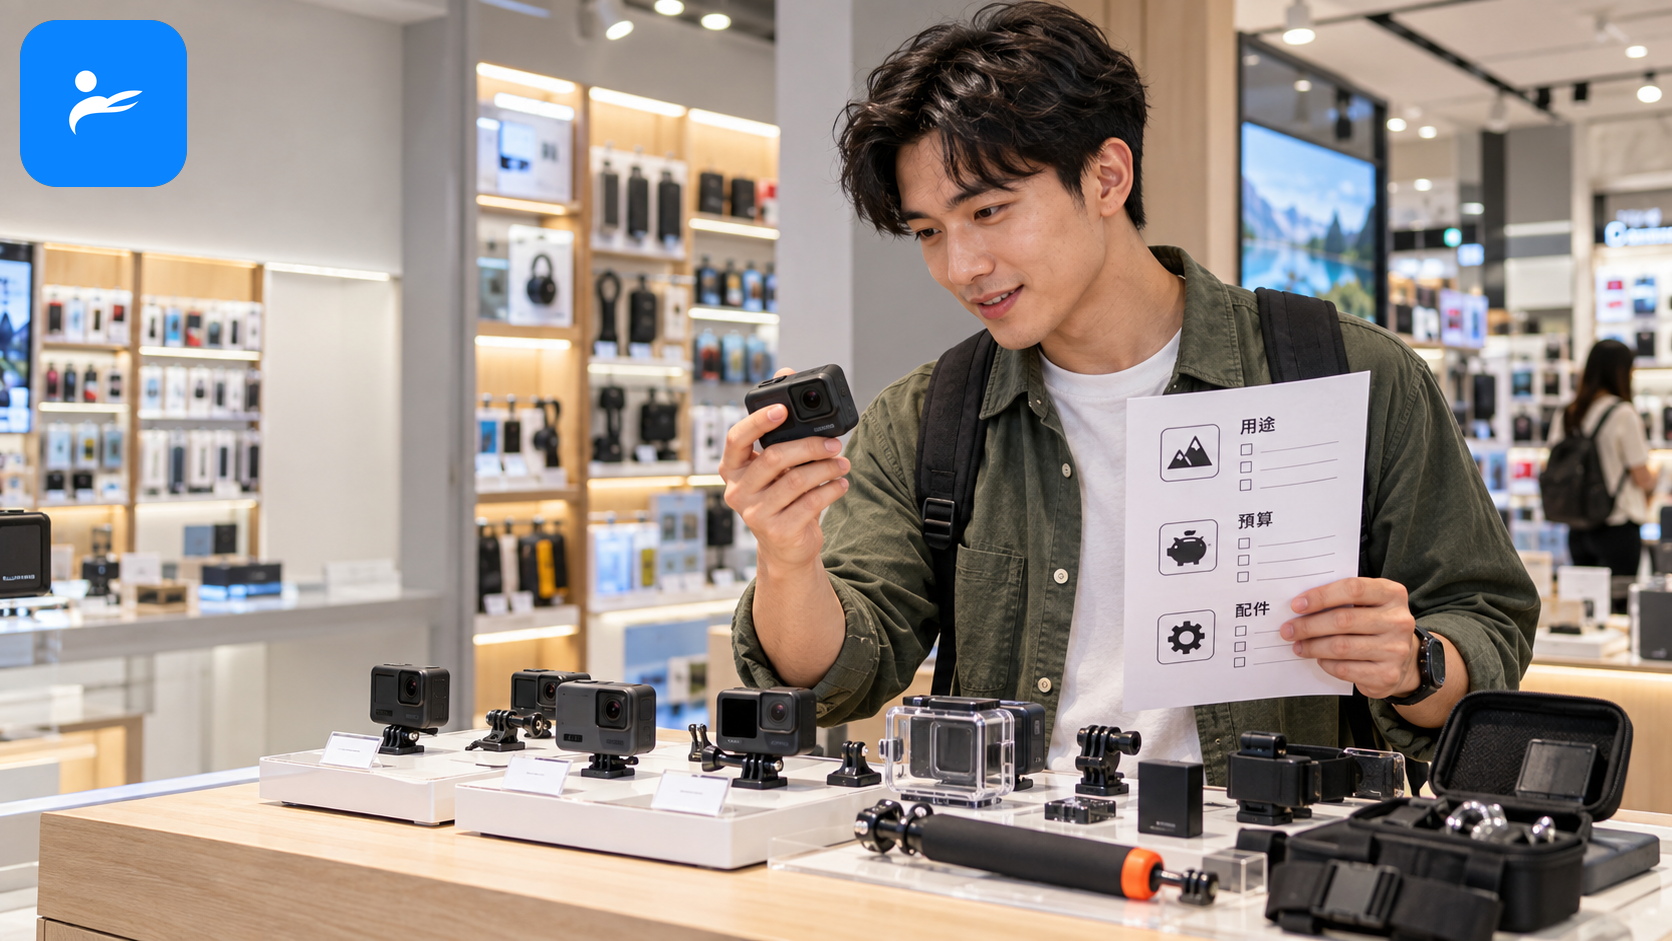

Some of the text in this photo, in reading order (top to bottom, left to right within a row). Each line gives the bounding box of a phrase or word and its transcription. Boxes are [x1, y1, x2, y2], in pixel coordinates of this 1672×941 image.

[1240, 416, 1276, 435] 用途
[1237, 511, 1274, 529] 預算
[1235, 601, 1271, 618] 配件
